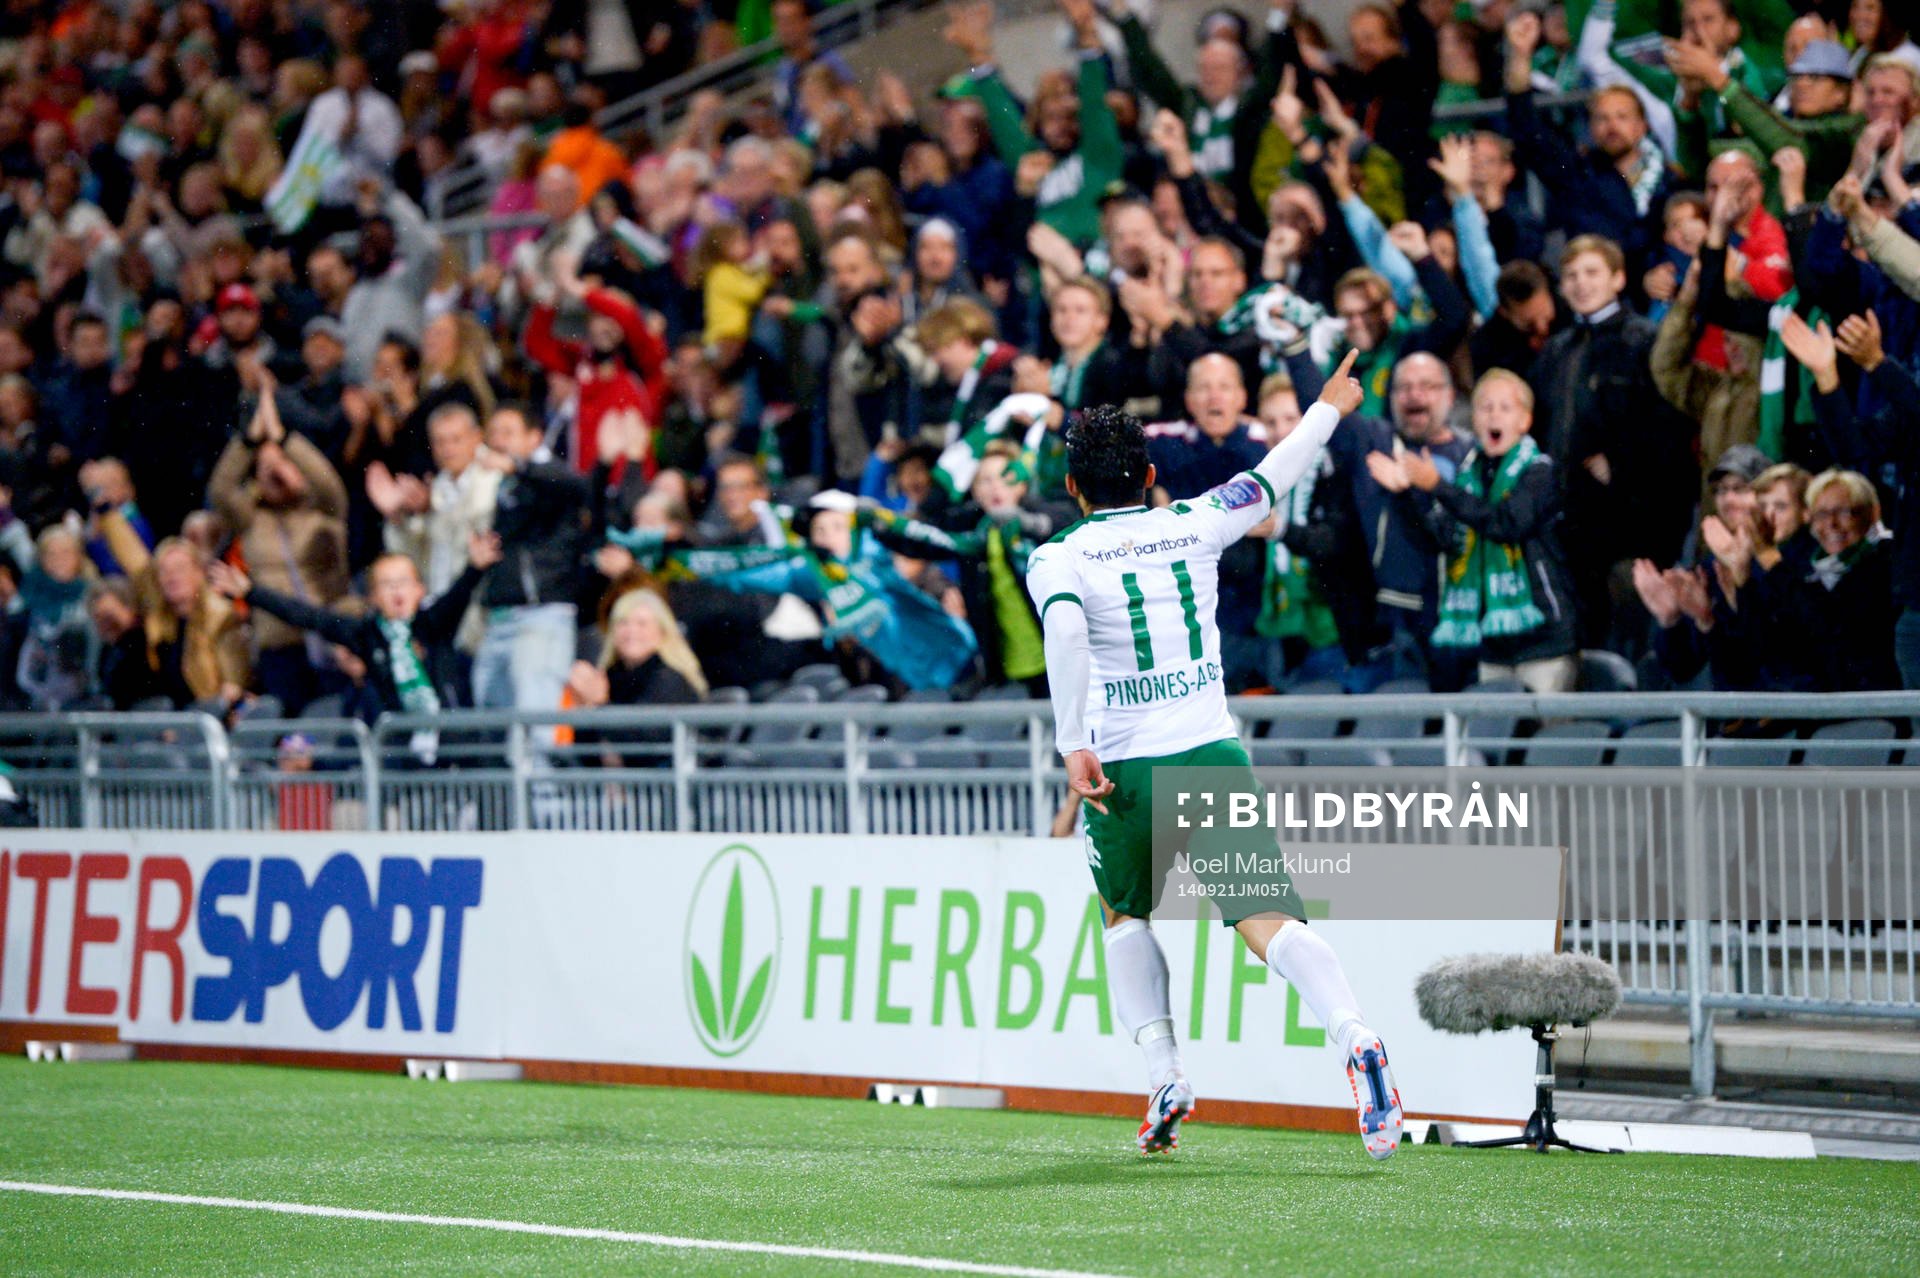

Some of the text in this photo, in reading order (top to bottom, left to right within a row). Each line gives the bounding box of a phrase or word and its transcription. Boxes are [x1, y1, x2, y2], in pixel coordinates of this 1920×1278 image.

[1133, 533, 1202, 557] pantbank
[1122, 560, 1203, 672] 11
[0, 849, 484, 1033] TERSPORT
[803, 885, 1331, 1048] HERBAIFE
